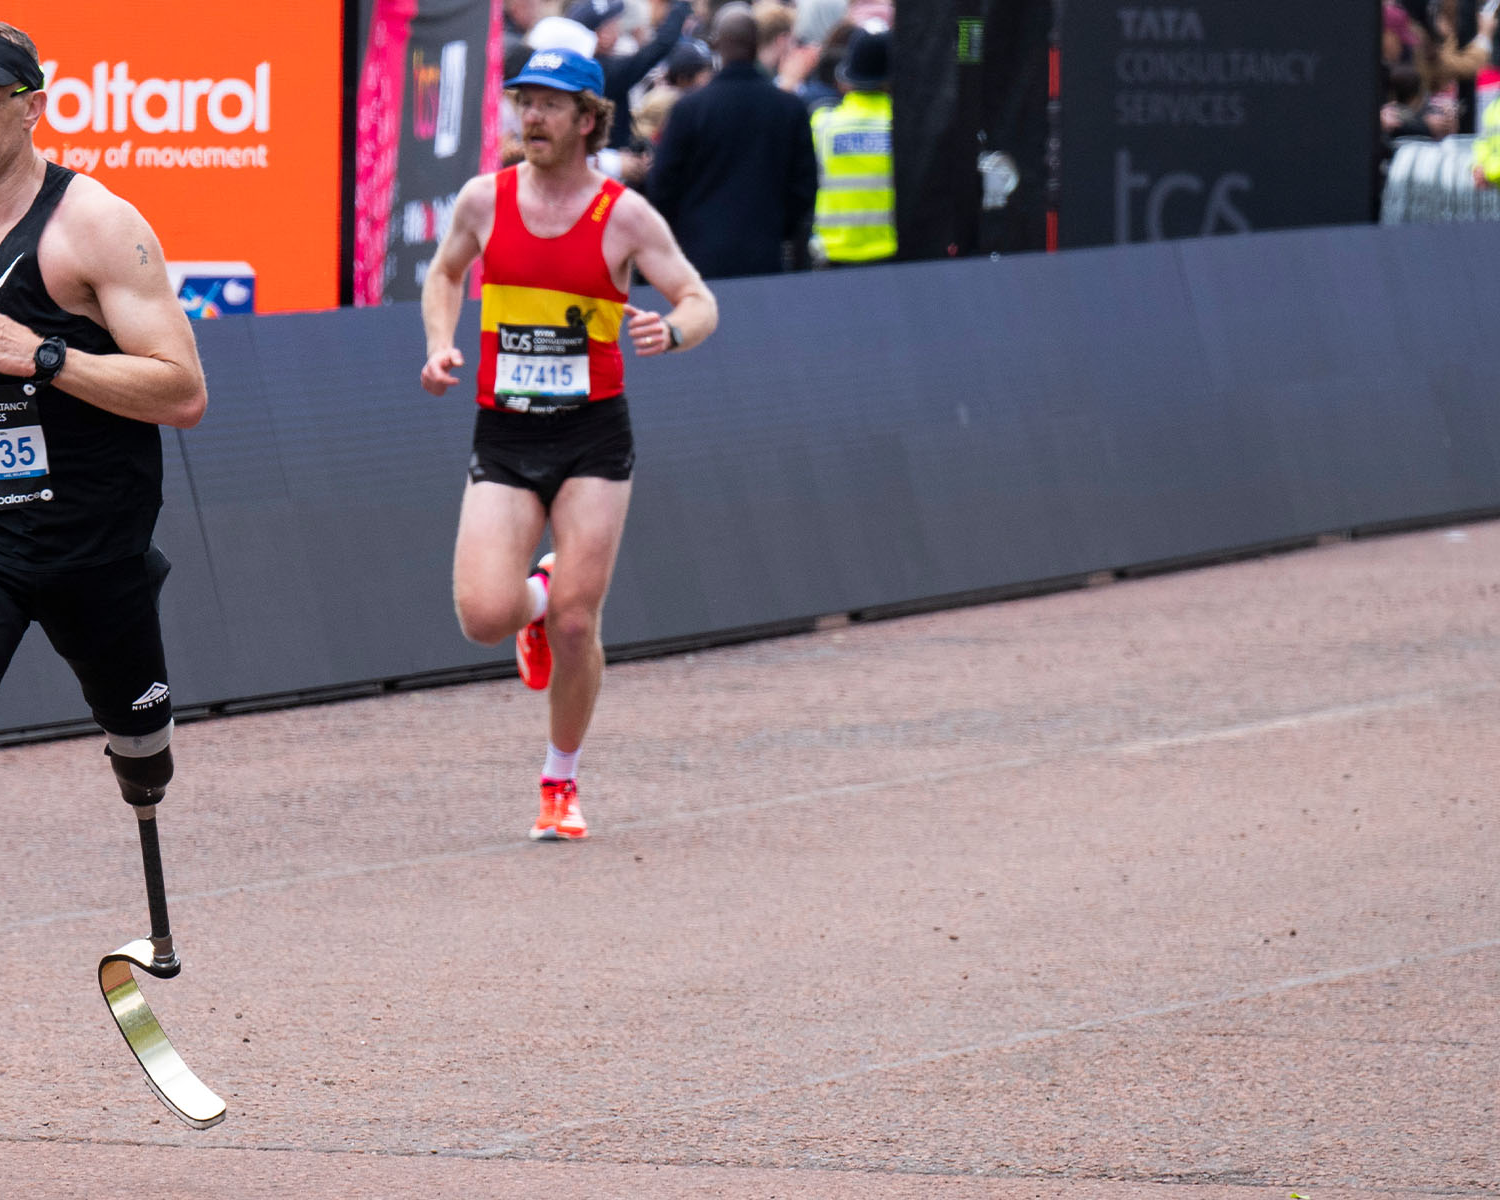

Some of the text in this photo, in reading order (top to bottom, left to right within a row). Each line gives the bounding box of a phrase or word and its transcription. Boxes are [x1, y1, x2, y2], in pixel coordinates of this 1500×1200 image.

[1116, 8, 1205, 40] TATA
[1115, 50, 1319, 83] CONSULTANCY
[1115, 91, 1246, 125] SERVICES
[63, 141, 101, 172] joy
[105, 140, 132, 168] of
[135, 144, 268, 169] movement
[511, 364, 573, 386] 47415
[132, 701, 154, 711] NIKE
